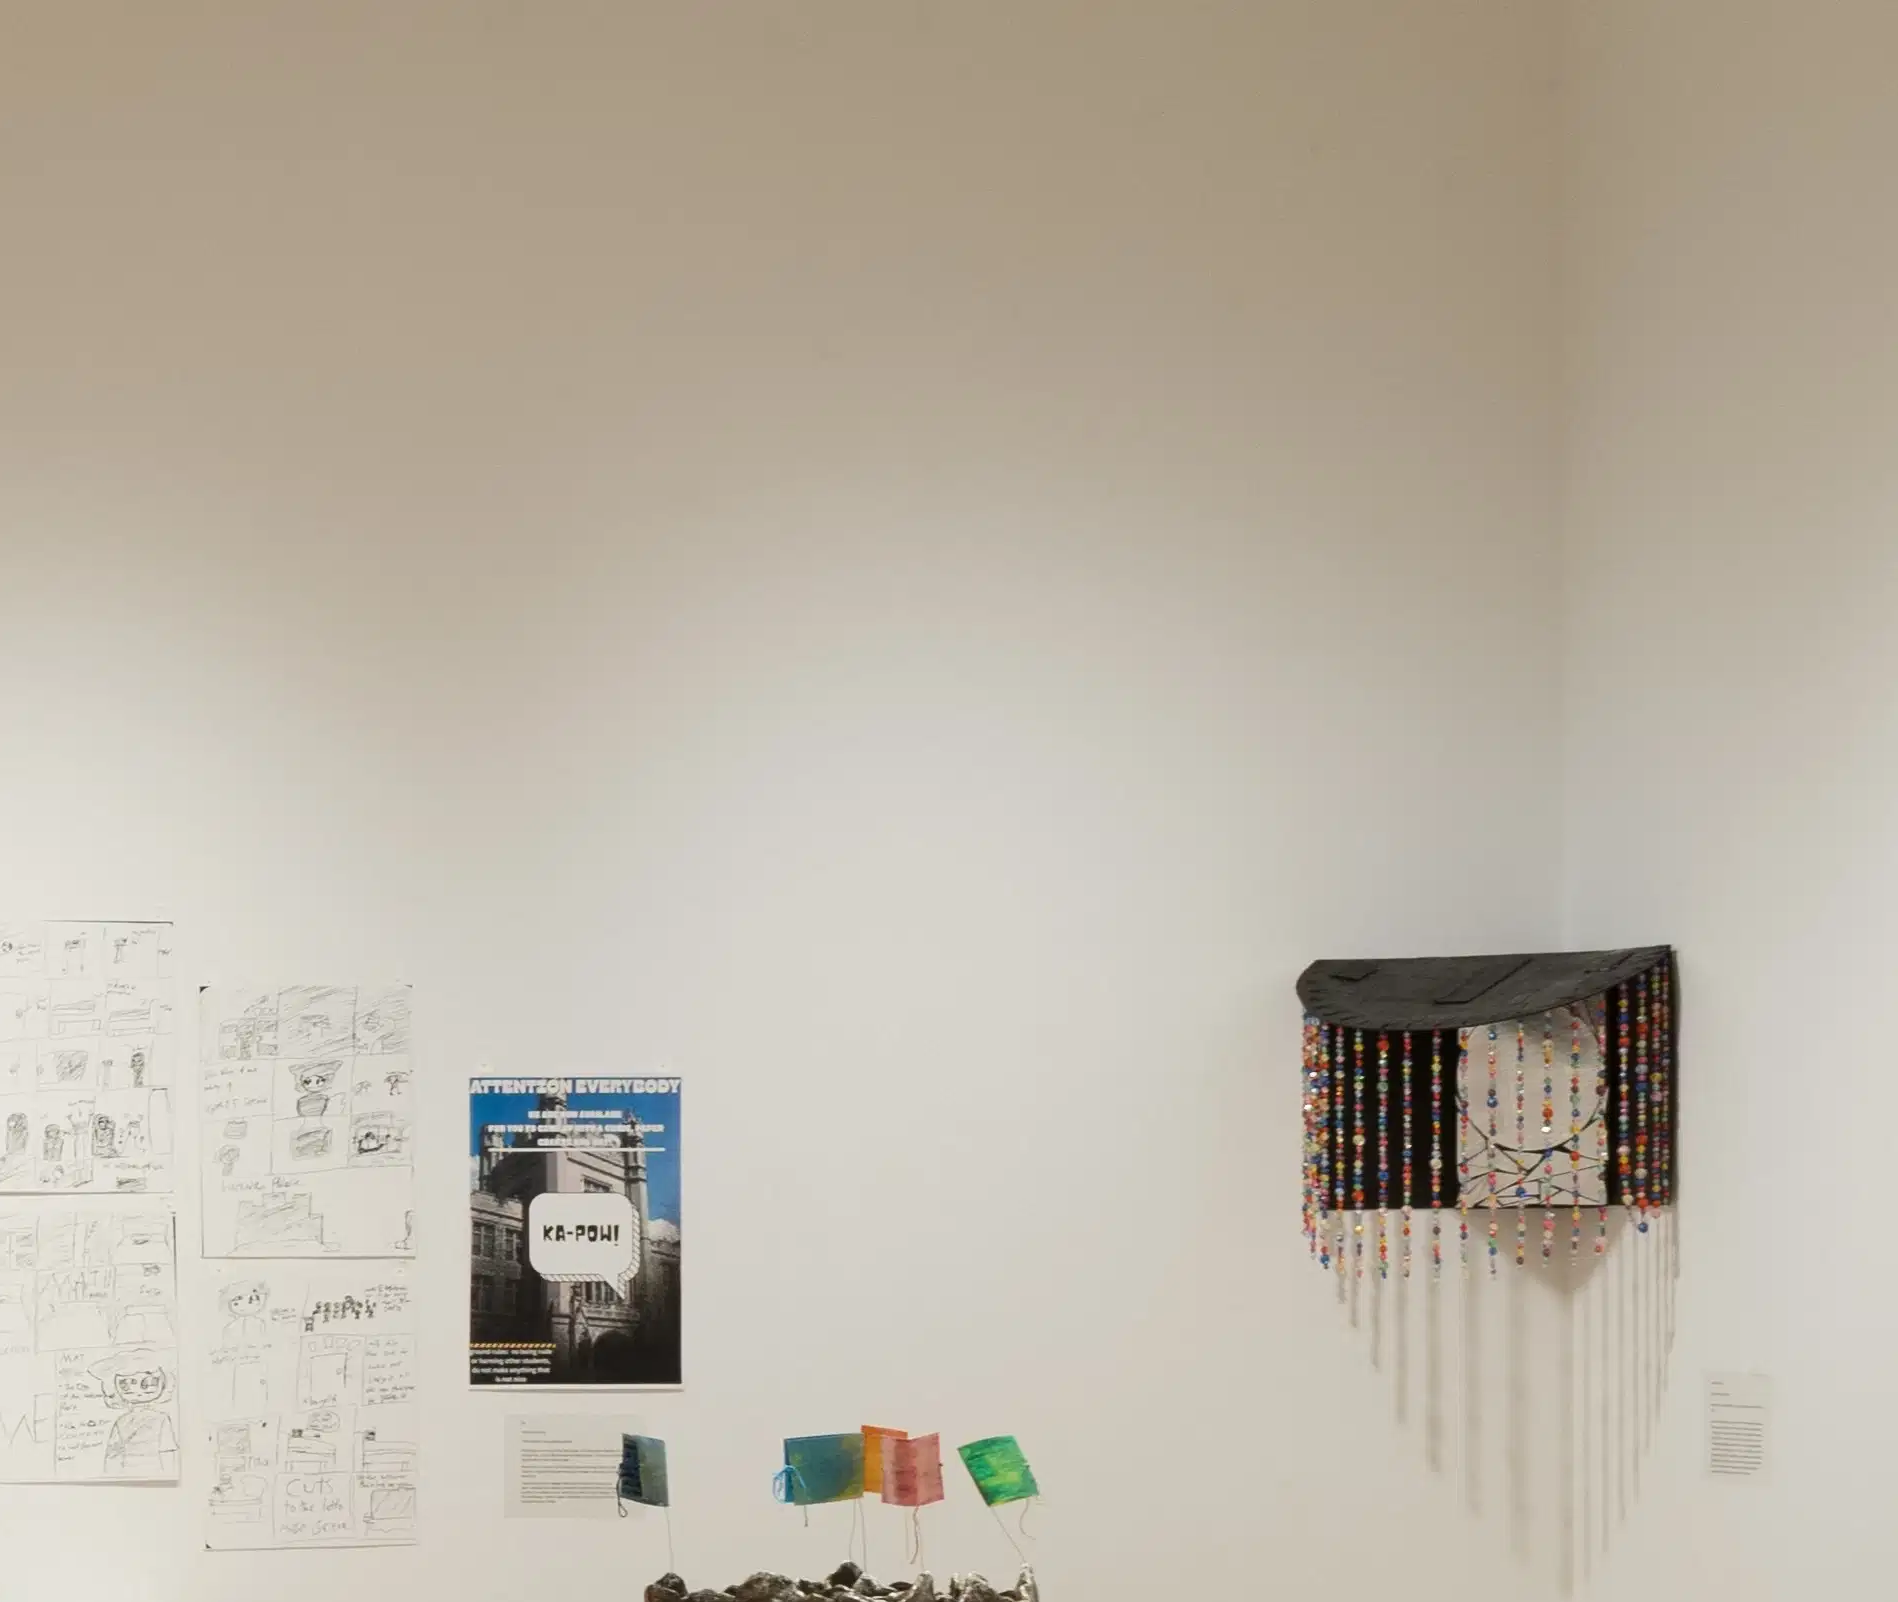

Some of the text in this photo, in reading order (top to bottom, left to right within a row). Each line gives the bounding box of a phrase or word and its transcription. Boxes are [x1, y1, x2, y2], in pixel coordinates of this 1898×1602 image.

[470, 1079, 680, 1095] ATTENTION EVERYBODY
[543, 1225, 620, 1246] KA-POW!
